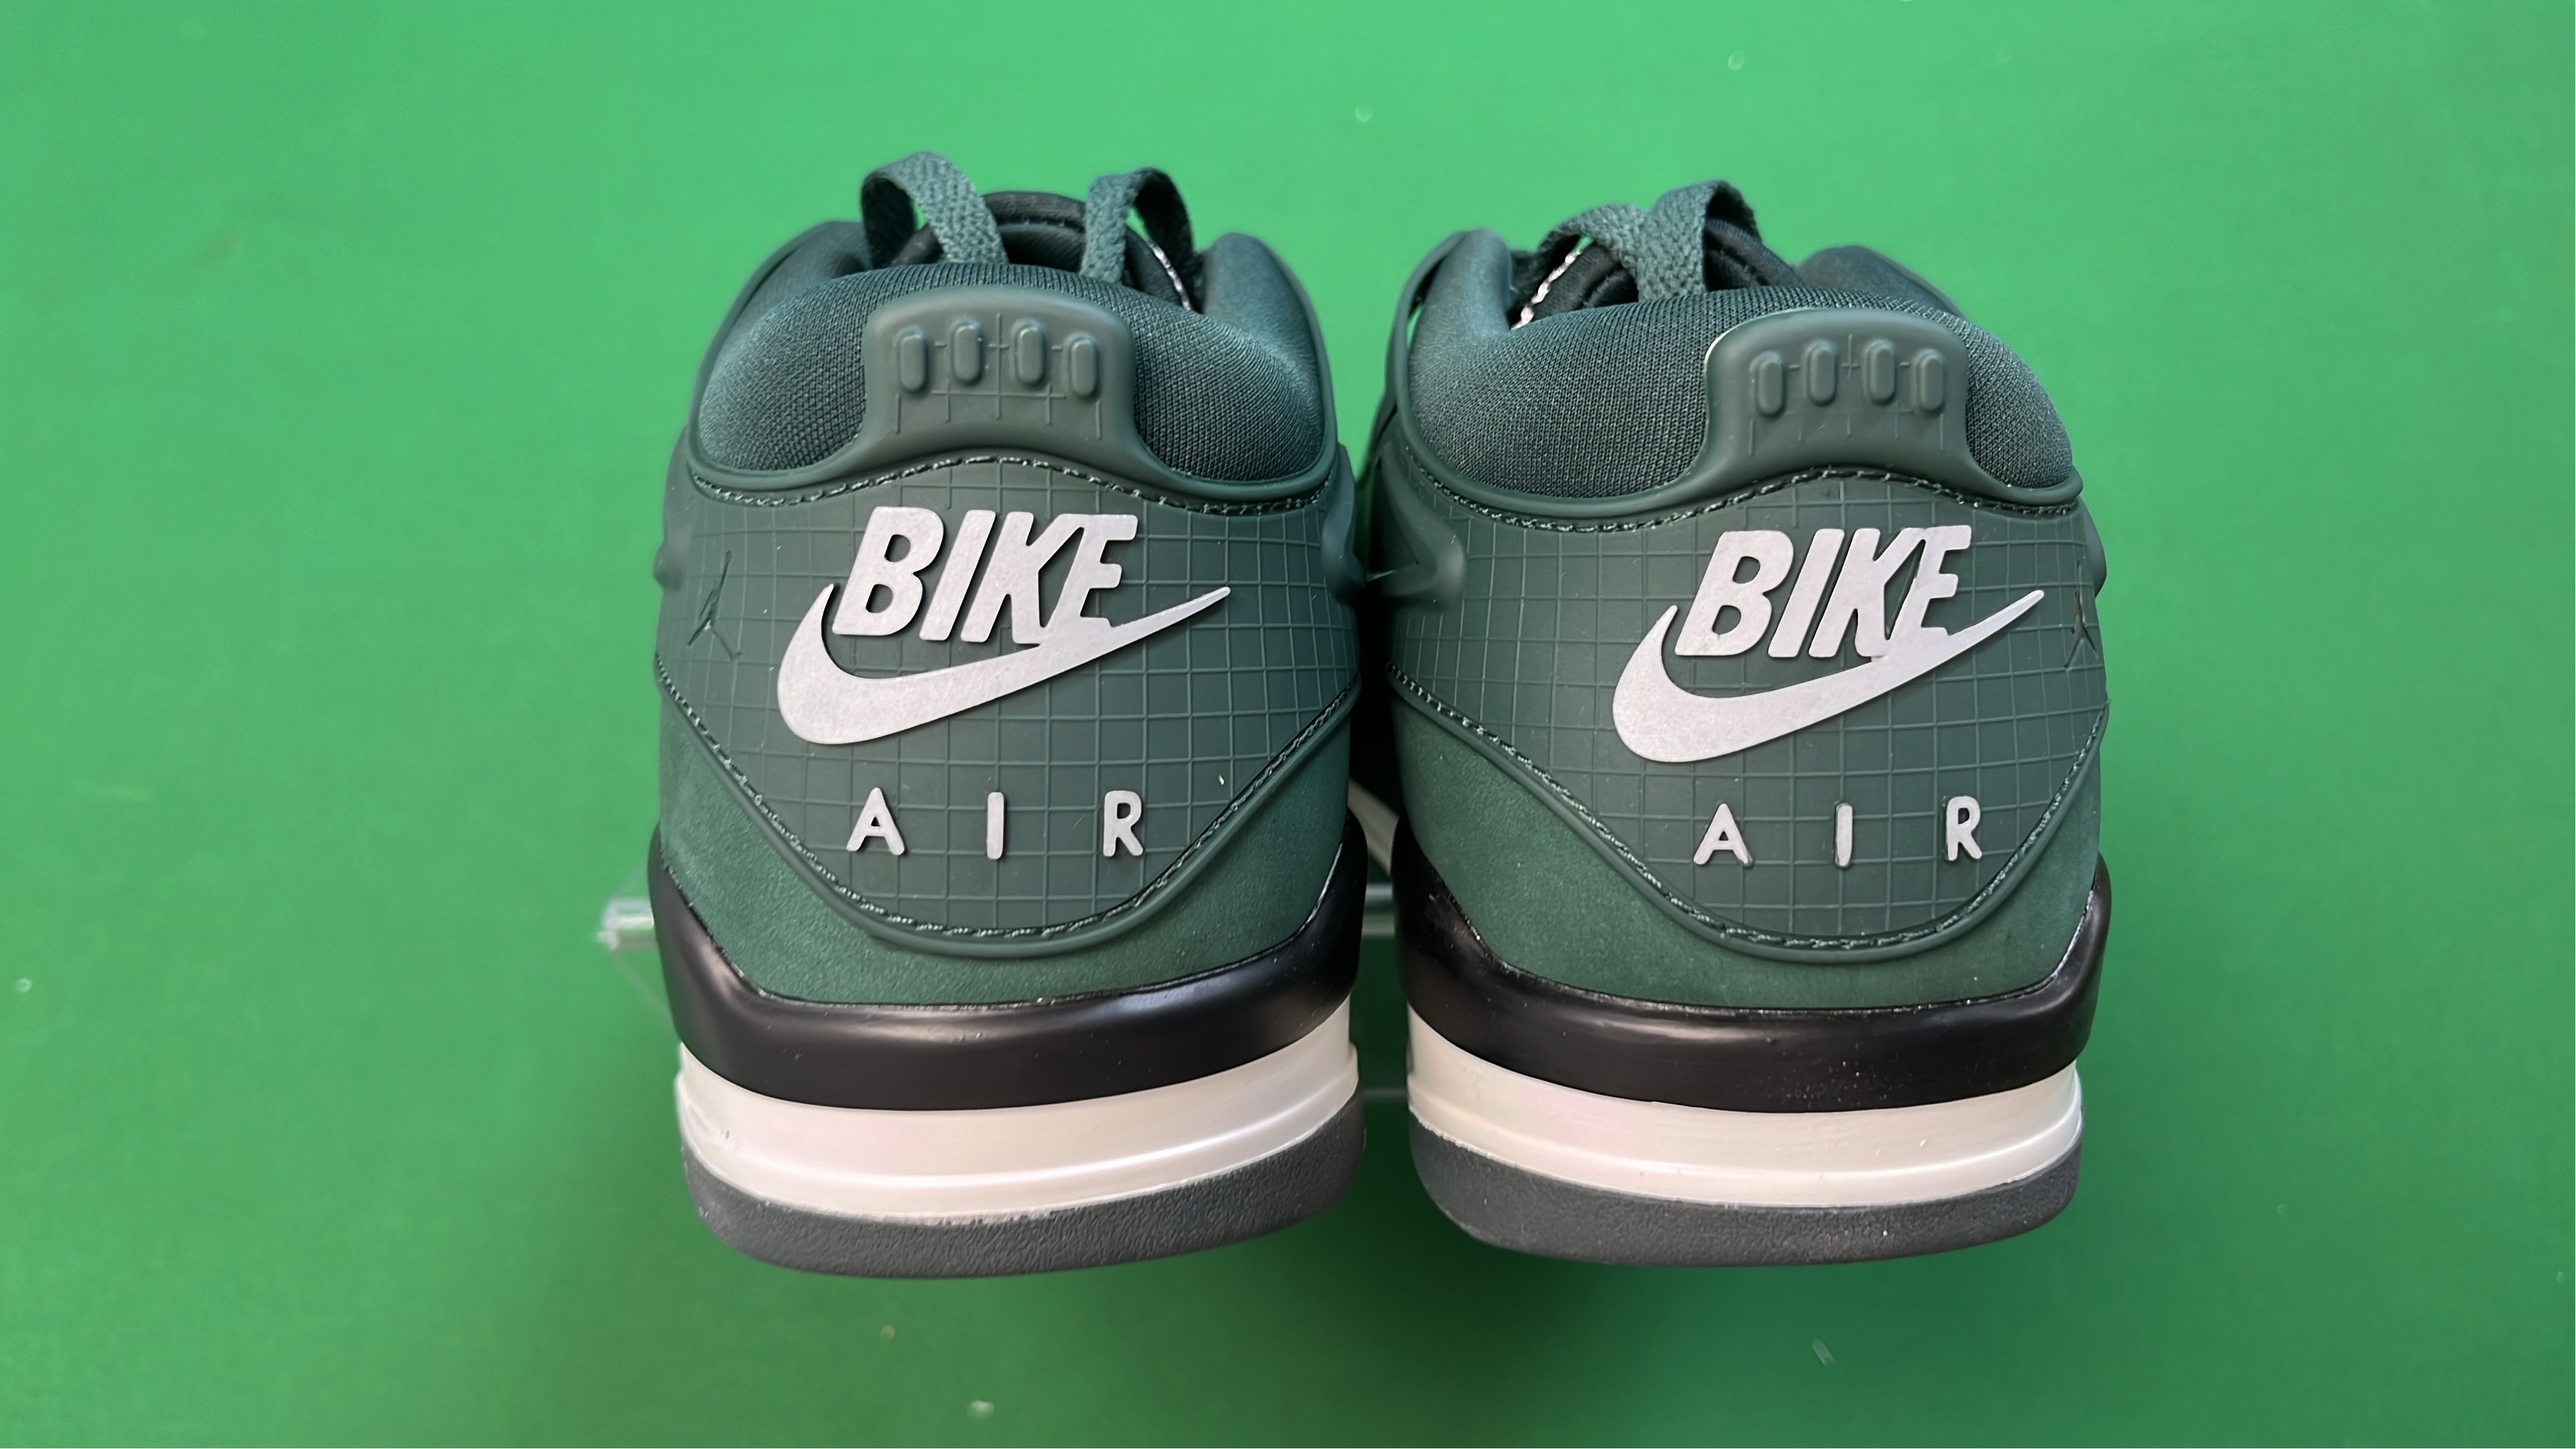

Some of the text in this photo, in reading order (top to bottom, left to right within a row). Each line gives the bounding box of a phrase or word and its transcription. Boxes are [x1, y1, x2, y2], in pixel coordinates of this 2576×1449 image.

[833, 506, 1139, 645] BIKE
[1675, 526, 1972, 658] BIKE
[846, 788, 1143, 860] AIR
[1693, 796, 1982, 867] AIR
